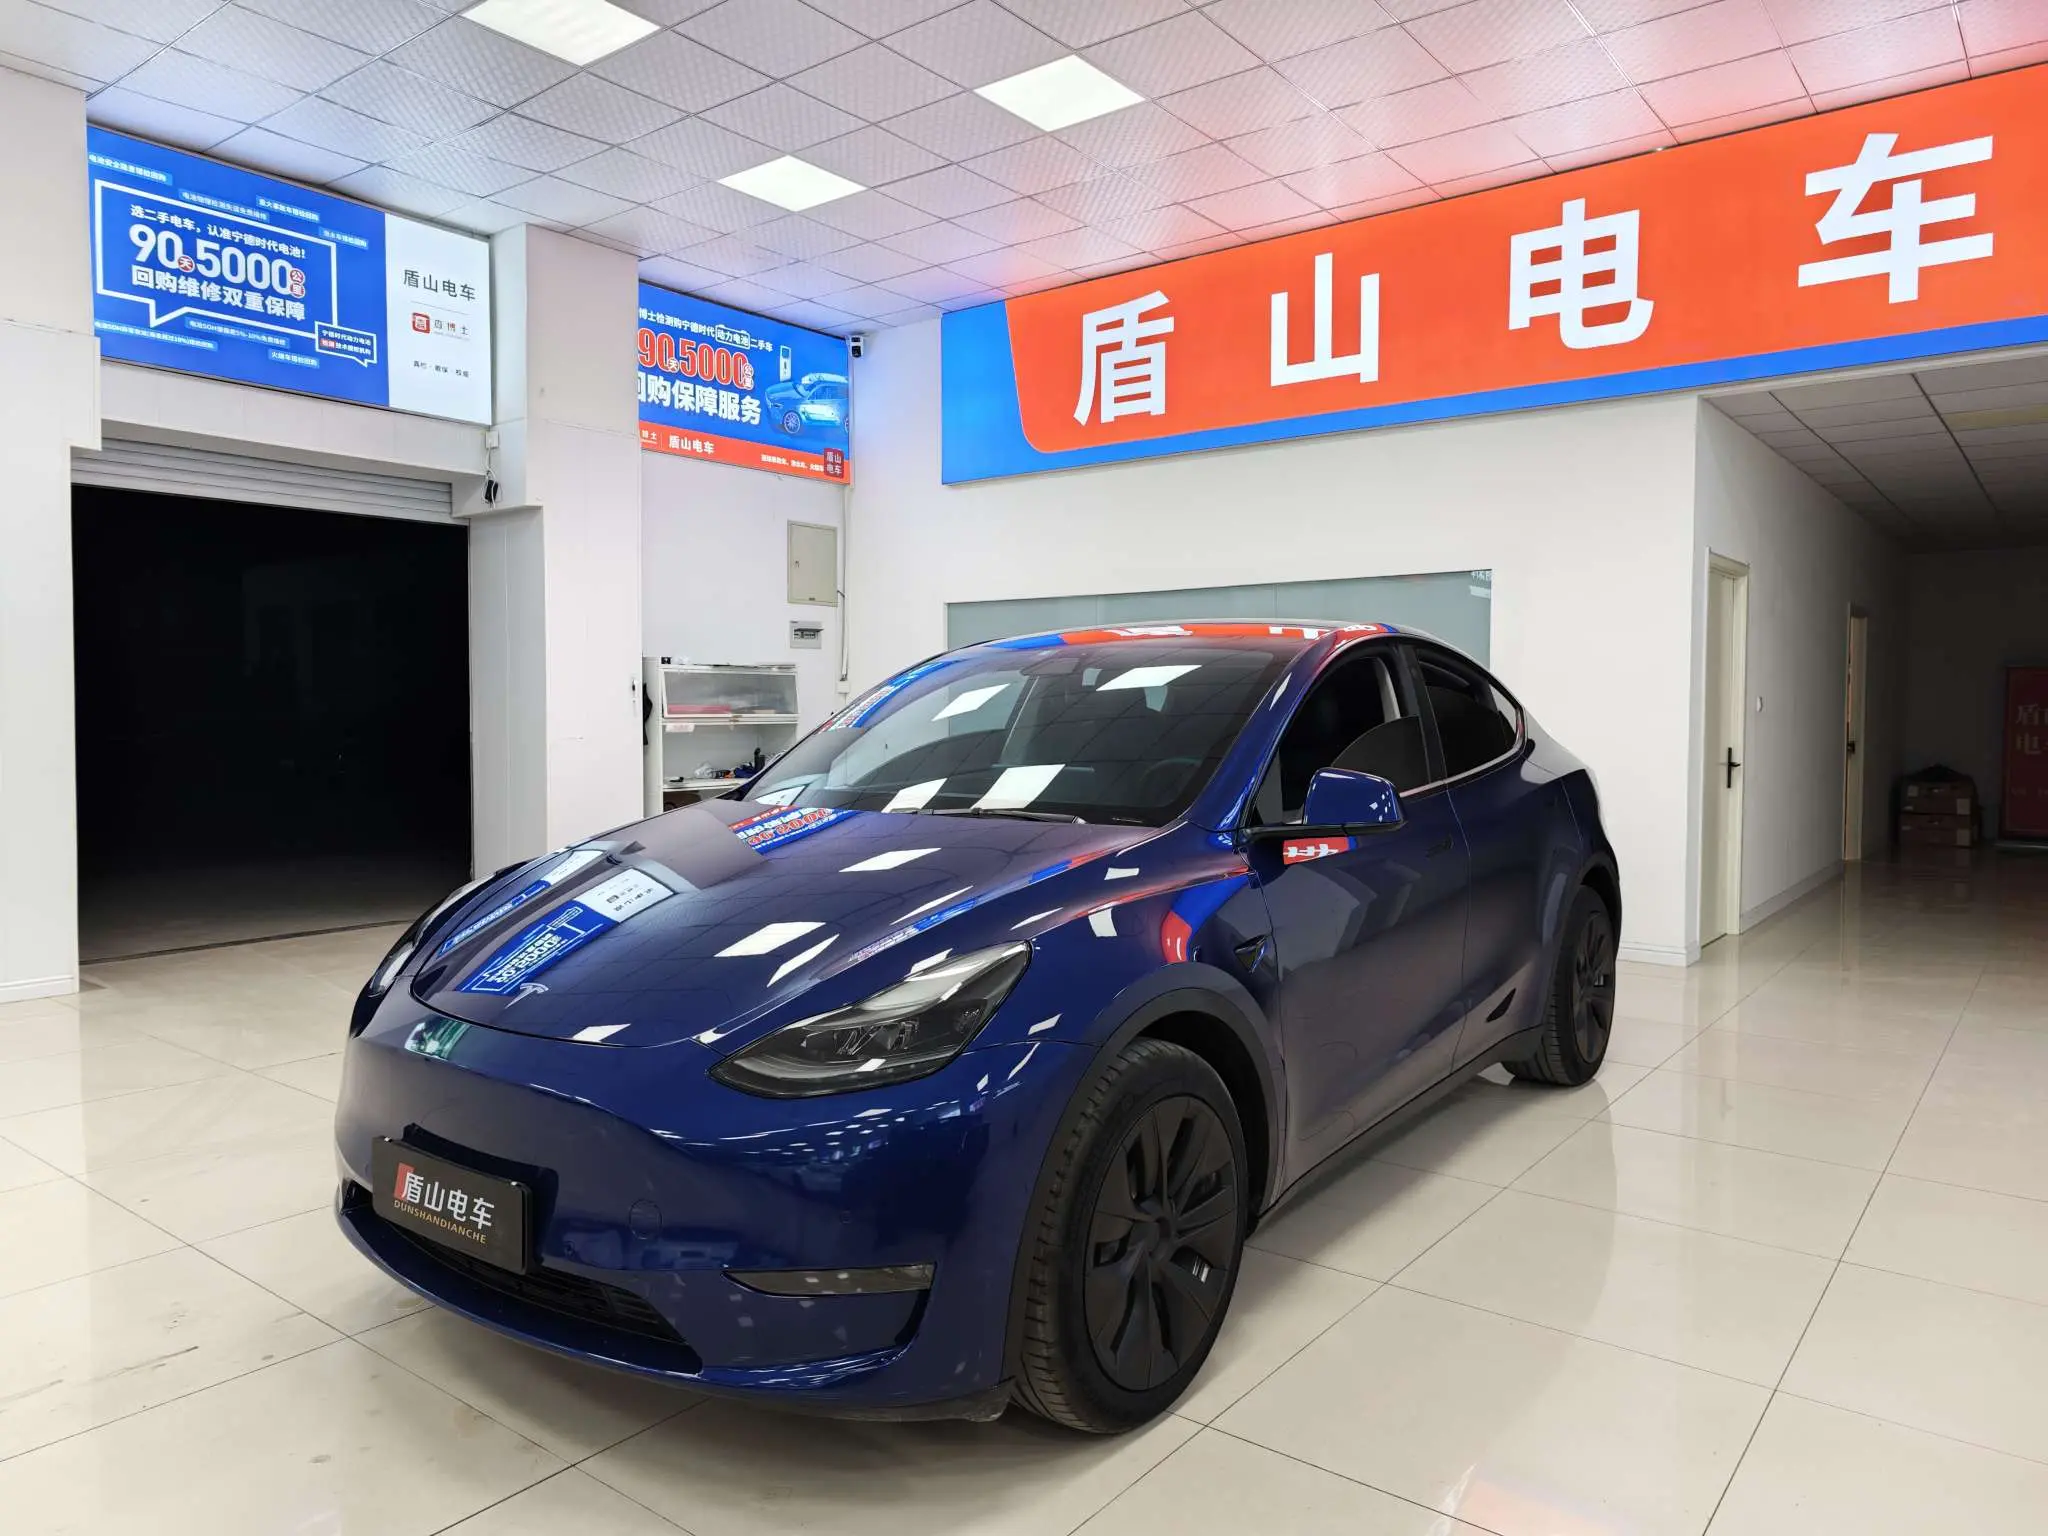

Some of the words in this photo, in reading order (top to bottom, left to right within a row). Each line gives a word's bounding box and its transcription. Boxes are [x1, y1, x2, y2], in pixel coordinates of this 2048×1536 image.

[131, 264, 306, 321] 回购维修双重保障
[403, 269, 476, 301] 盾山电车
[1073, 132, 1995, 427] 盾山电车
[668, 434, 715, 455] 盾山电车
[394, 1200, 488, 1244] DUNSHANDIANCHE
[402, 1171, 495, 1230] 盾山电车
